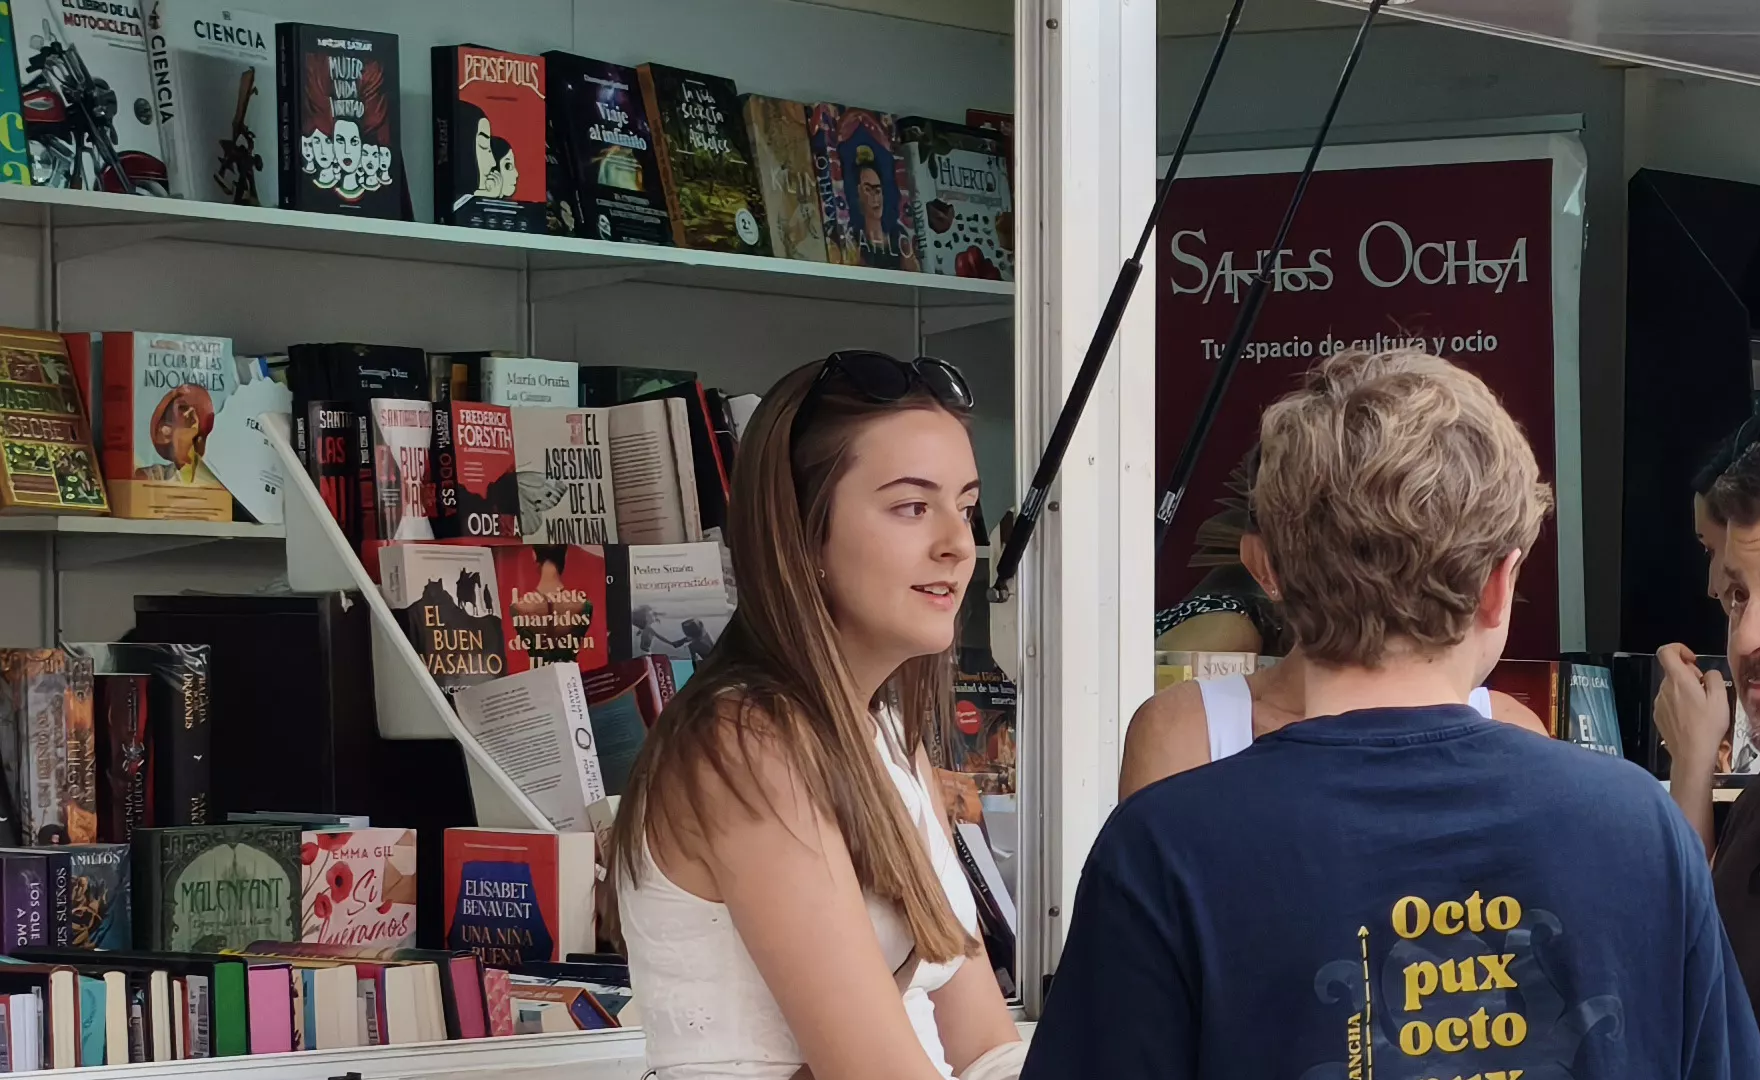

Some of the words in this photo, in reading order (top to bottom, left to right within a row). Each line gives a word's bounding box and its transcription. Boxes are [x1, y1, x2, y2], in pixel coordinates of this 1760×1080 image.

[63, 12, 143, 37] MOTOCICLETA
[194, 19, 266, 49] CIENCIA
[151, 35, 174, 124] CIENCIA
[328, 55, 363, 80] MUJER
[334, 79, 357, 99] VIDA
[596, 101, 628, 128] Viaje
[938, 156, 997, 192] HUERTO
[1358, 220, 1528, 293] OCHOA
[1236, 336, 1314, 363] spacio
[1318, 332, 1345, 357] de
[1433, 335, 1446, 358] y
[1450, 329, 1498, 354] ocio
[507, 371, 536, 386] María
[459, 409, 508, 427] FREDERICK
[585, 413, 600, 446] EL
[457, 424, 513, 449] FORSYTH
[316, 437, 346, 464] LAS
[545, 448, 603, 480] ASESINO
[569, 482, 587, 514] DE
[589, 482, 607, 514] LA
[545, 517, 609, 544] MONTAÑA
[424, 605, 445, 626] EL
[512, 610, 590, 627] maridos
[433, 629, 483, 651] BUEN
[508, 632, 531, 651] de
[534, 633, 595, 654] Evelyn
[420, 653, 503, 675] VASALLO
[182, 673, 194, 729] DRAGONES
[1578, 714, 1598, 742] EL
[332, 847, 369, 860] EMMA
[373, 845, 394, 858] GIL
[29, 882, 40, 908] LOS
[181, 877, 283, 913] MALENFANT
[346, 868, 378, 916] Si
[16, 907, 27, 920] A
[462, 898, 533, 919] BENAVENT
[1391, 890, 1522, 939] Octo
[29, 911, 41, 940] QUE
[461, 924, 492, 944] UNA
[496, 925, 533, 946] NIÑA
[1402, 953, 1518, 1012] pux
[1399, 1006, 1528, 1056] octo
